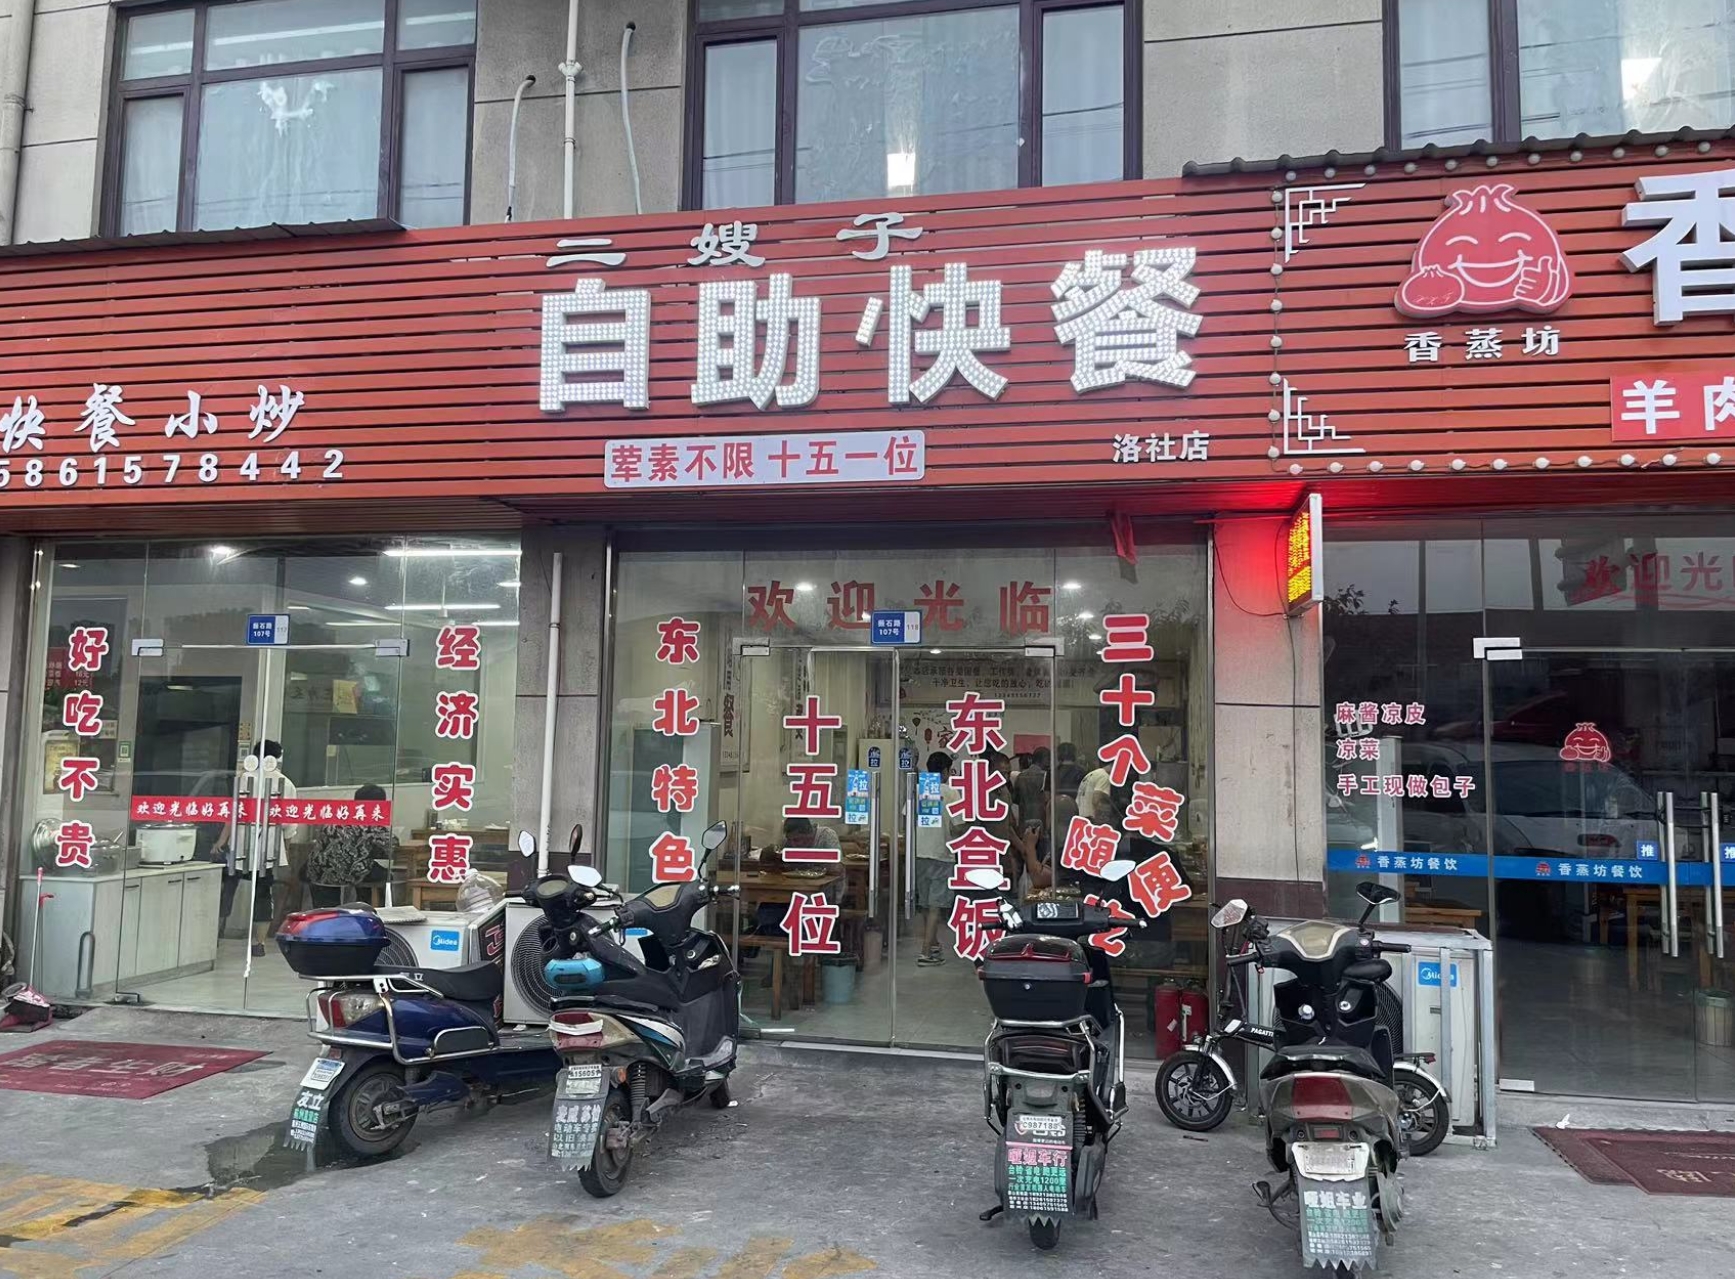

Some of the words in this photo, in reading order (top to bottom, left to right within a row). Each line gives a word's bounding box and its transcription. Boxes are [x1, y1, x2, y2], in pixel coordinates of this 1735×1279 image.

[545, 212, 923, 267] 二嫂子
[1619, 169, 1735, 326] 香
[538, 246, 1204, 412] 自助快餐
[1403, 325, 1561, 362] 香蒸坊
[0, 383, 305, 452] 快餐小炒
[1620, 376, 1735, 434] 羊肉
[610, 435, 919, 483] 荤素不限十五一位
[1111, 430, 1210, 463] 洛社店
[748, 579, 1054, 634] 欢迎光临
[1336, 702, 1426, 725] 麻酱凉皮
[57, 626, 108, 869] 好吃不贵
[427, 624, 480, 884] 经济实惠
[648, 616, 701, 884] 东北特色
[1336, 738, 1380, 760] 凉菜
[136, 801, 248, 818] 欢迎光临好再来
[1337, 774, 1475, 798] 手工现做包子
[269, 803, 386, 821] 欢迎光临好再来
[780, 695, 842, 956] 十五一位
[946, 691, 1010, 962] 东北盒饭
[1377, 855, 1458, 871] 香蒸坊餐饮
[1558, 863, 1643, 879] 香蒸坊餐饮
[1640, 844, 1655, 857] 推
[433, 936, 458, 946] Midea
